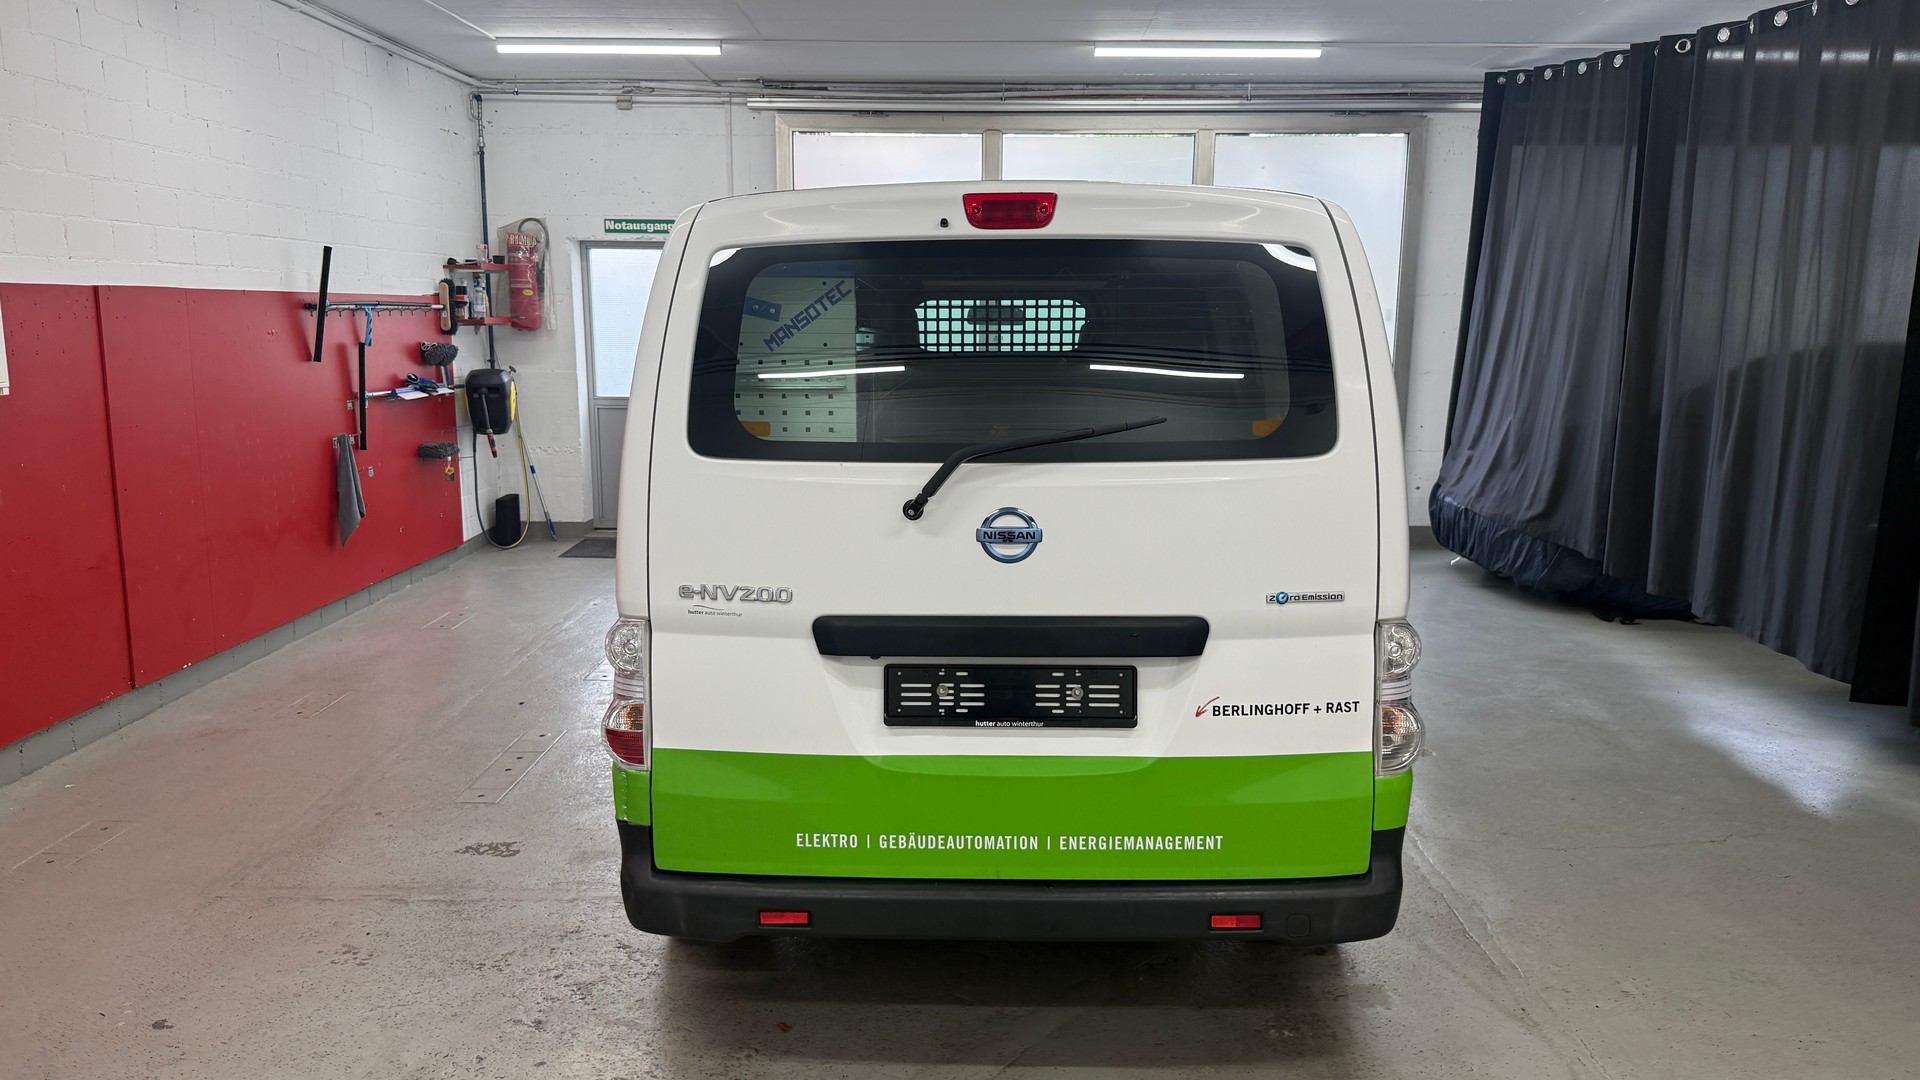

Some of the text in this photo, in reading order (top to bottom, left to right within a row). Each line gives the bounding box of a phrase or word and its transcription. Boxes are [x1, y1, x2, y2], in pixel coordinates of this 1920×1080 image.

[605, 221, 674, 233] Notausgang
[763, 280, 853, 353] MANSOTEC
[983, 531, 1036, 540] NISSAN
[1302, 593, 1343, 601] Emission
[1212, 703, 1310, 717] BERLINGHOFF
[1326, 701, 1360, 714] RAST
[1011, 720, 1044, 728] winterthur
[796, 833, 858, 848] ELEKTRO
[879, 832, 1039, 850] GEBÄUDEAUTOMATION
[1059, 835, 1224, 850] ENERGIEMANAGEMENT
